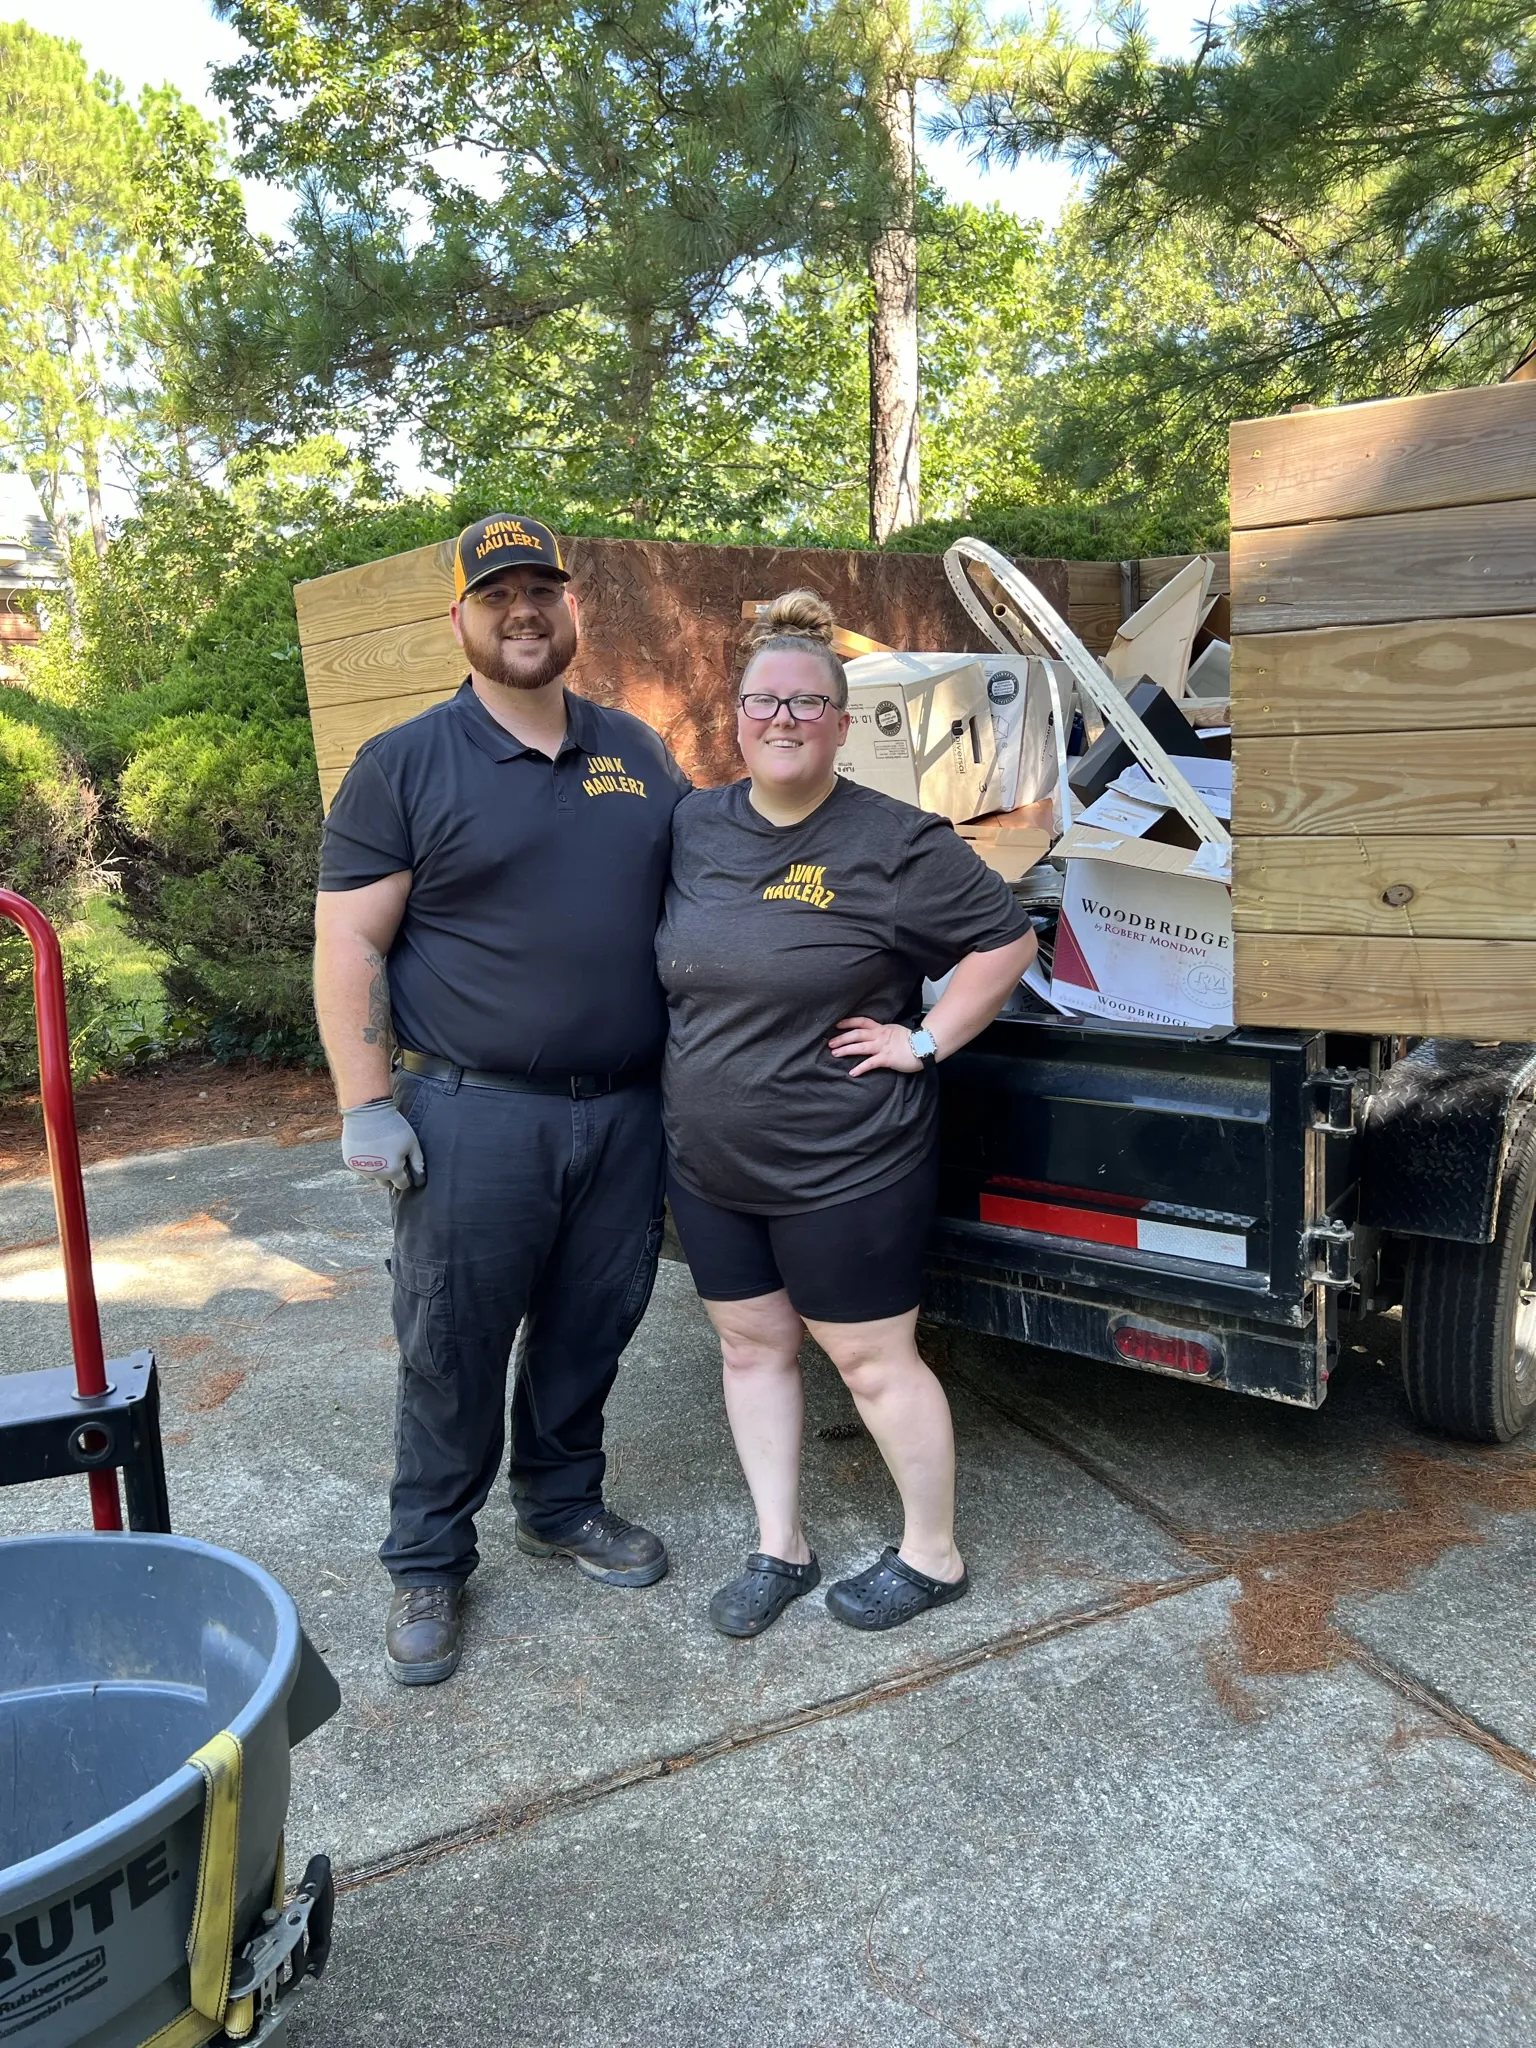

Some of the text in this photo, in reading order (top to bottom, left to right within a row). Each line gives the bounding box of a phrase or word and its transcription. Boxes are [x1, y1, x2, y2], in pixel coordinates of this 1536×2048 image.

[483, 520, 525, 539] JUNK
[475, 532, 543, 559] HAULERZ
[587, 756, 626, 774] JUNK
[582, 775, 647, 799] HAULERZ
[784, 864, 826, 885] JUNK
[763, 884, 835, 909] HAULERZ
[1081, 897, 1229, 949] WOODBRIDGE
[1094, 922, 1207, 958] by ROBERT MONDAVI
